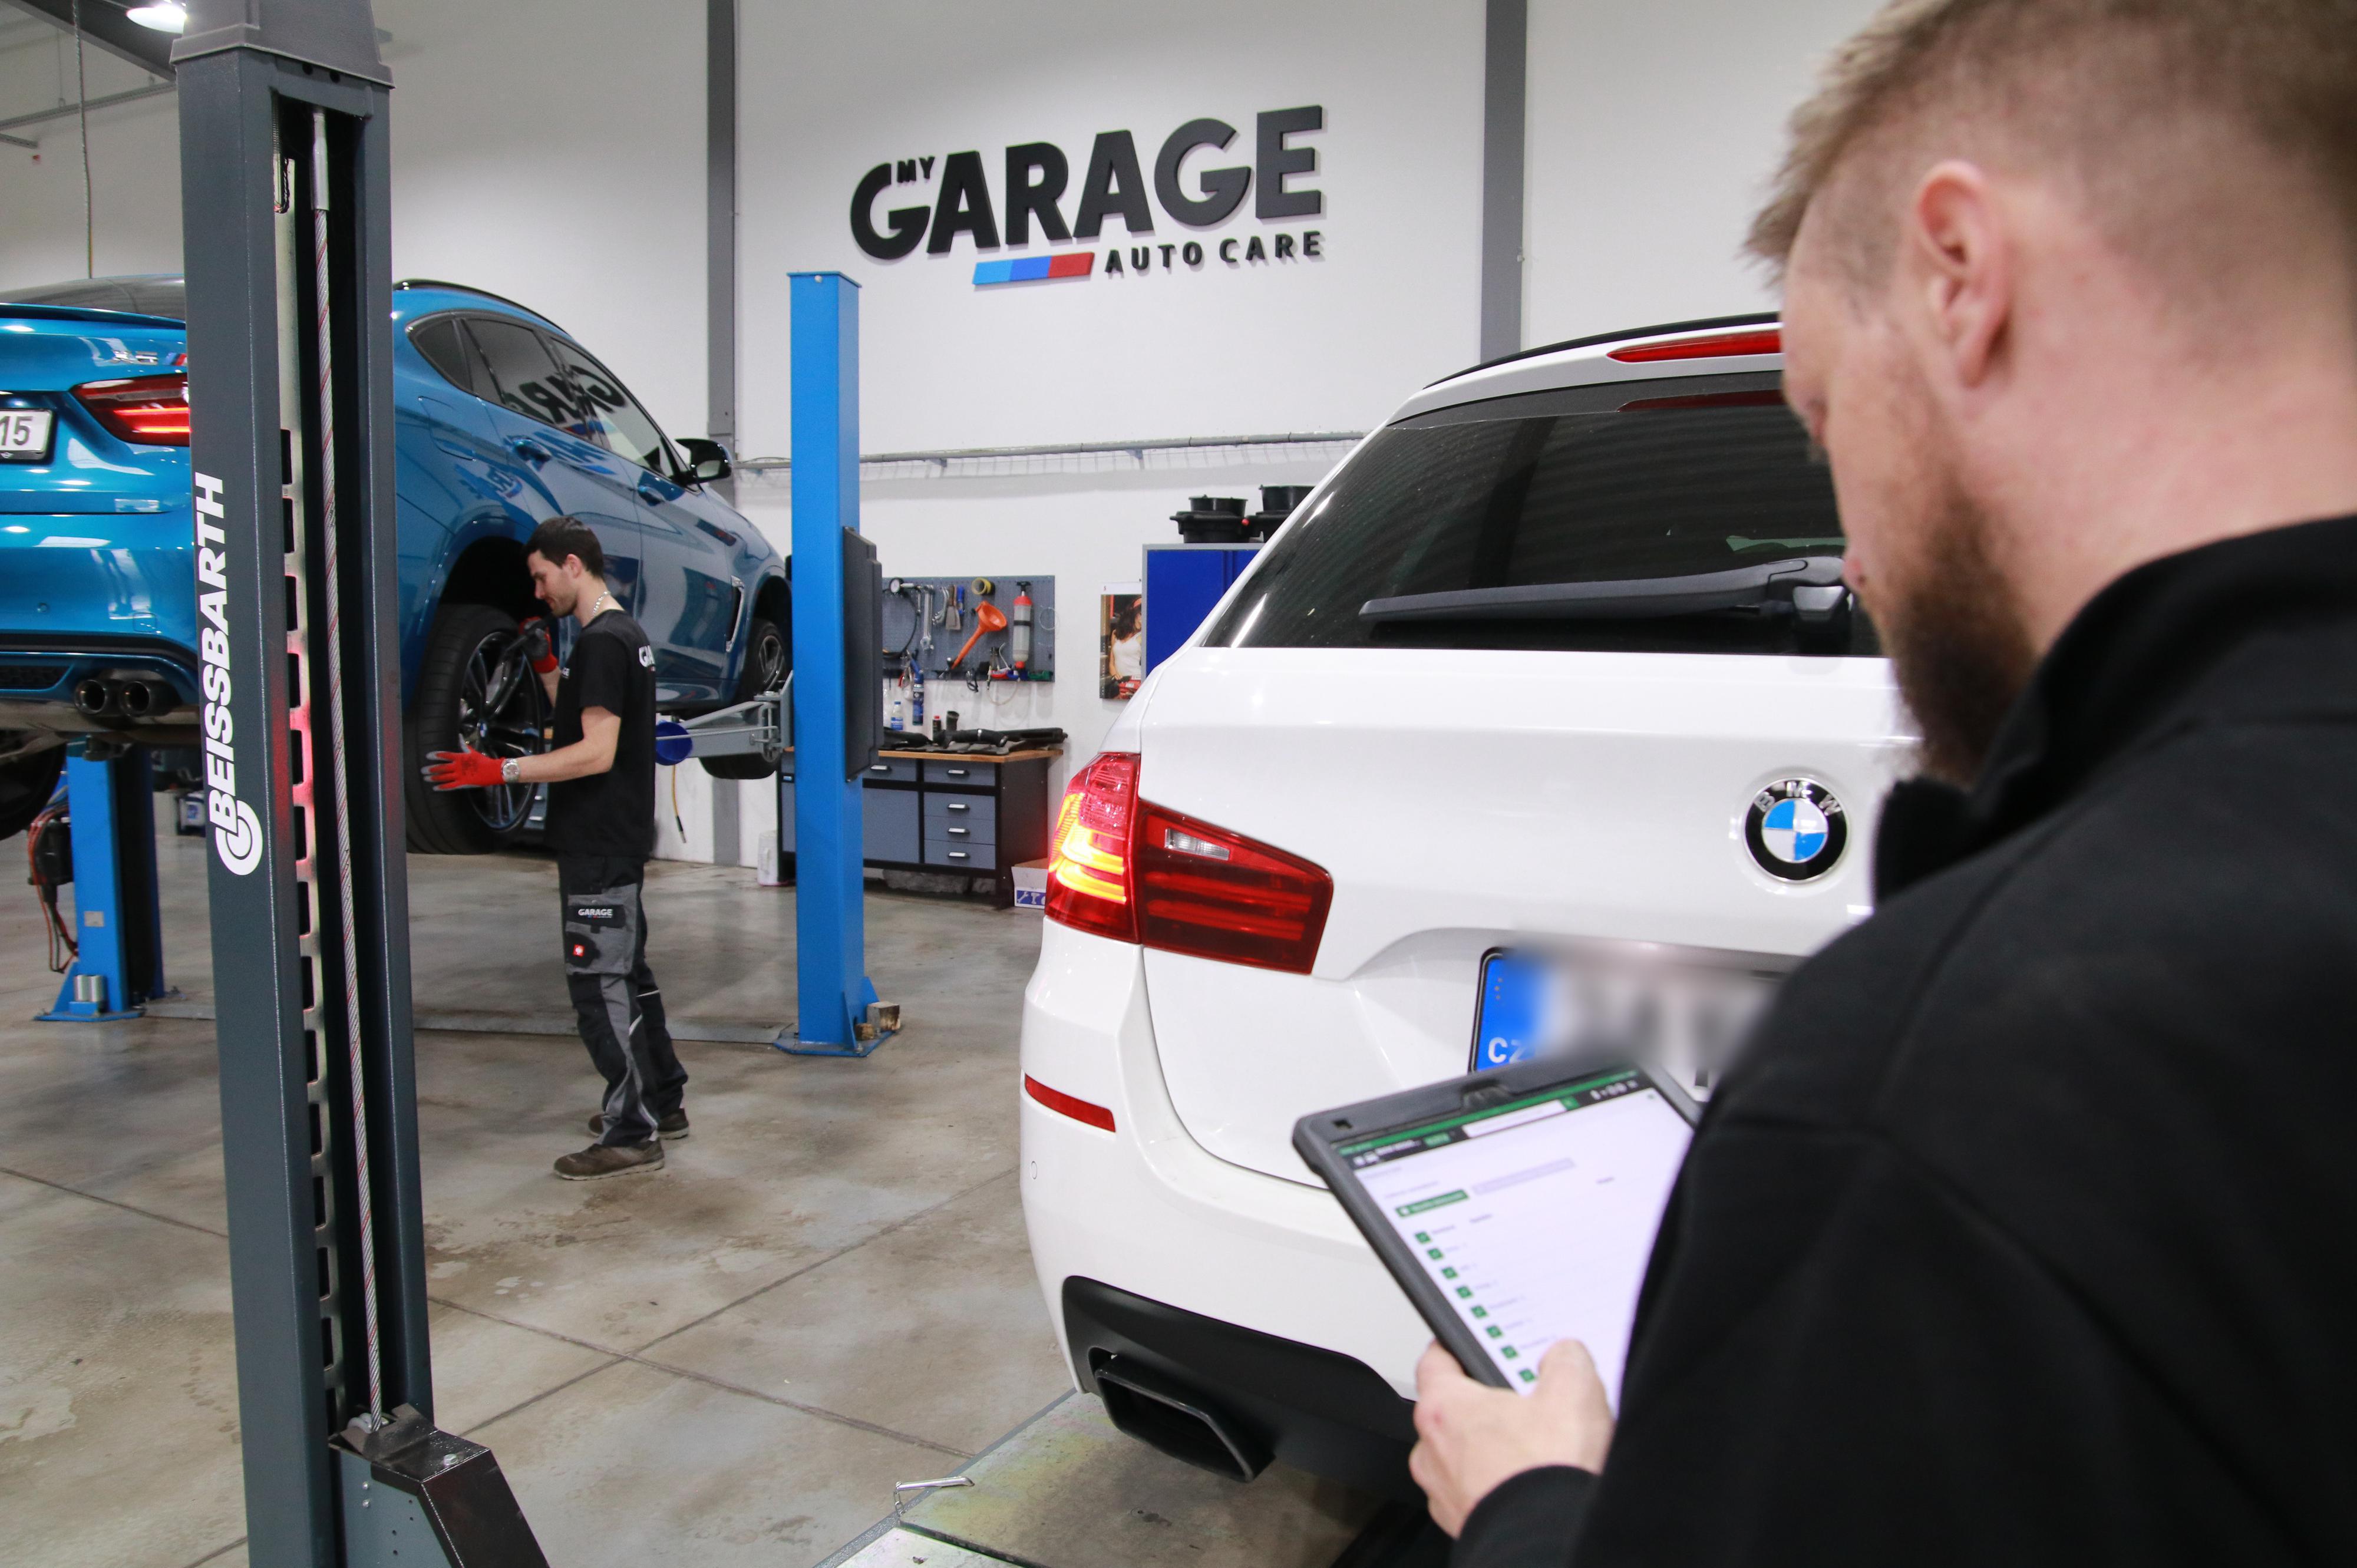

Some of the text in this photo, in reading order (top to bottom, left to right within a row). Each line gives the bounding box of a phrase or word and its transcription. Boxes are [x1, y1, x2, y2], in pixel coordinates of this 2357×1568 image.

[850, 105, 1323, 260] GARAGE
[896, 156, 936, 183] MY
[1104, 230, 1322, 273] AUTO CARE
[195, 471, 239, 834] BEISSBARTH
[1754, 781, 1841, 817] BMW
